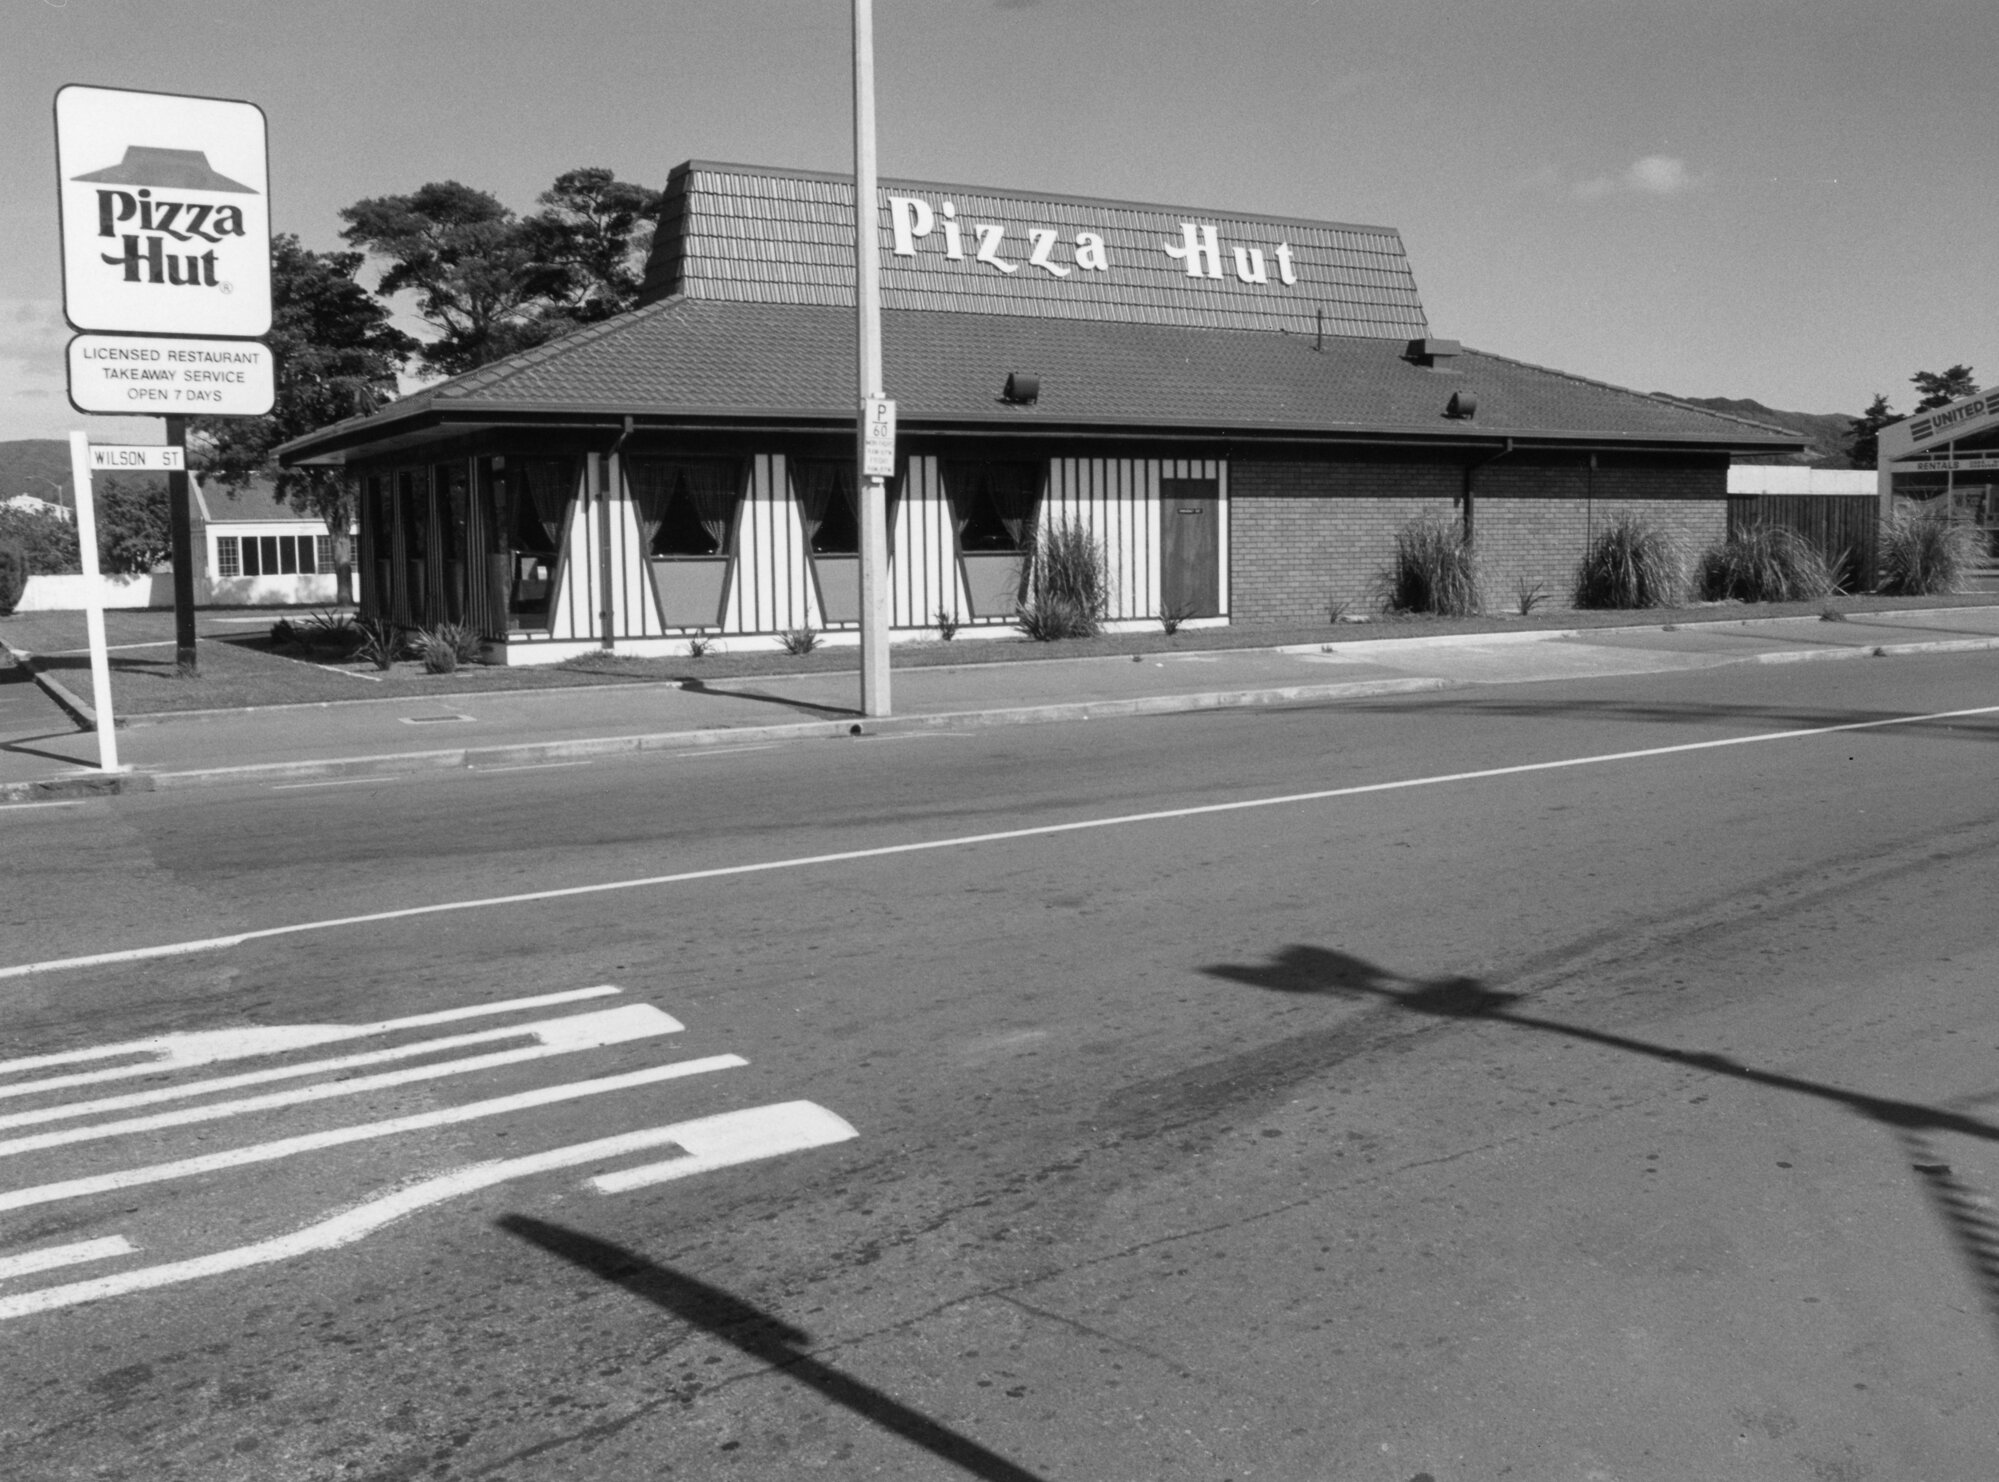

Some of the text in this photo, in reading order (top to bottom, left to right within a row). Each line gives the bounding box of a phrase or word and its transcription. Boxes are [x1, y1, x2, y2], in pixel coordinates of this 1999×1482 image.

[96, 188, 246, 243] Pizza
[889, 197, 1297, 286] Pizza Hut
[101, 234, 219, 287] Hut
[83, 348, 259, 365] LICENSED RESTAURANT
[103, 367, 245, 384] TAKEAWAY SERVICE
[127, 387, 222, 402] OPEN 7 DAYS
[877, 404, 886, 421] P
[1932, 401, 1985, 427] UNITED
[873, 425, 888, 437] 60
[95, 450, 179, 467] WILSON ST
[1917, 462, 1959, 470] RENTALS
